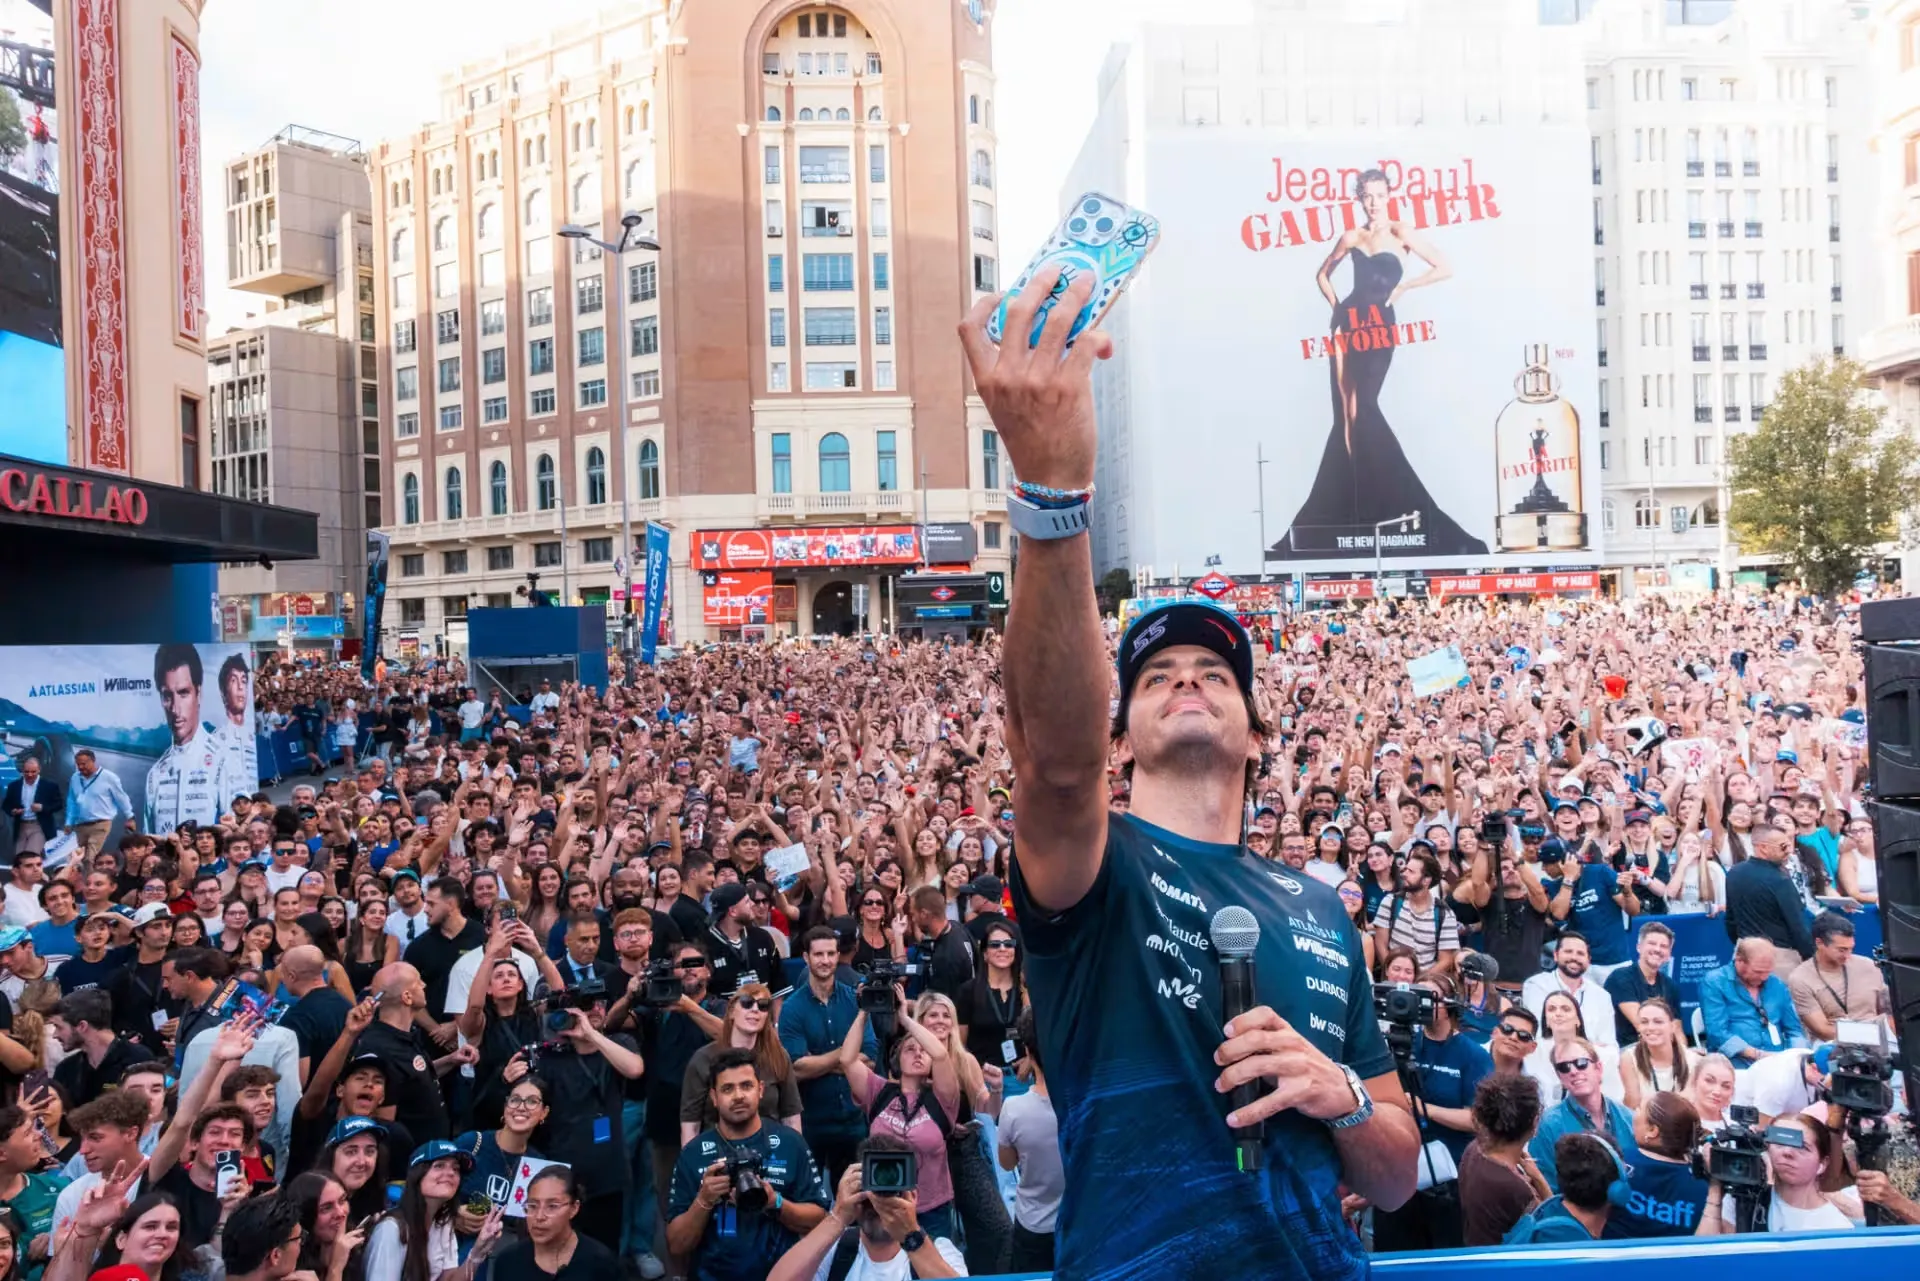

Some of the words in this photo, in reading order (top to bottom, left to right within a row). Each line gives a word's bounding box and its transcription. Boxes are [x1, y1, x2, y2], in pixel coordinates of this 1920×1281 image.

[1266, 157, 1361, 203] Jean
[1377, 158, 1479, 200] Paul
[1241, 183, 1502, 252] GAULTIER
[1348, 303, 1386, 330] LA
[1300, 319, 1437, 360] FAVORITE
[1555, 348, 1575, 358] NEW
[1528, 445, 1548, 461] LA
[1502, 456, 1577, 480] FAVORITE
[0, 468, 149, 525] CALLAO
[1336, 536, 1354, 548] THE
[1354, 535, 1375, 547] NEW
[1379, 534, 1427, 547] RAGRANCE
[1203, 581, 1227, 591] Metro
[1321, 584, 1360, 595] GUYS
[1440, 580, 1457, 591] POP
[1458, 579, 1482, 590] MART
[1496, 577, 1513, 589] POP
[1514, 577, 1537, 588] MART
[1552, 576, 1569, 587] POP
[1570, 575, 1593, 587] MART
[1130, 613, 1169, 663] 55
[39, 682, 96, 697] ATLASSIAN
[104, 677, 152, 692] Williams
[1150, 871, 1207, 913] KOMAT
[1288, 916, 1344, 944] ATLASSIAN
[1292, 934, 1350, 967] Williams
[1682, 955, 1717, 963] Descarga
[1626, 1190, 1696, 1228] Staff
